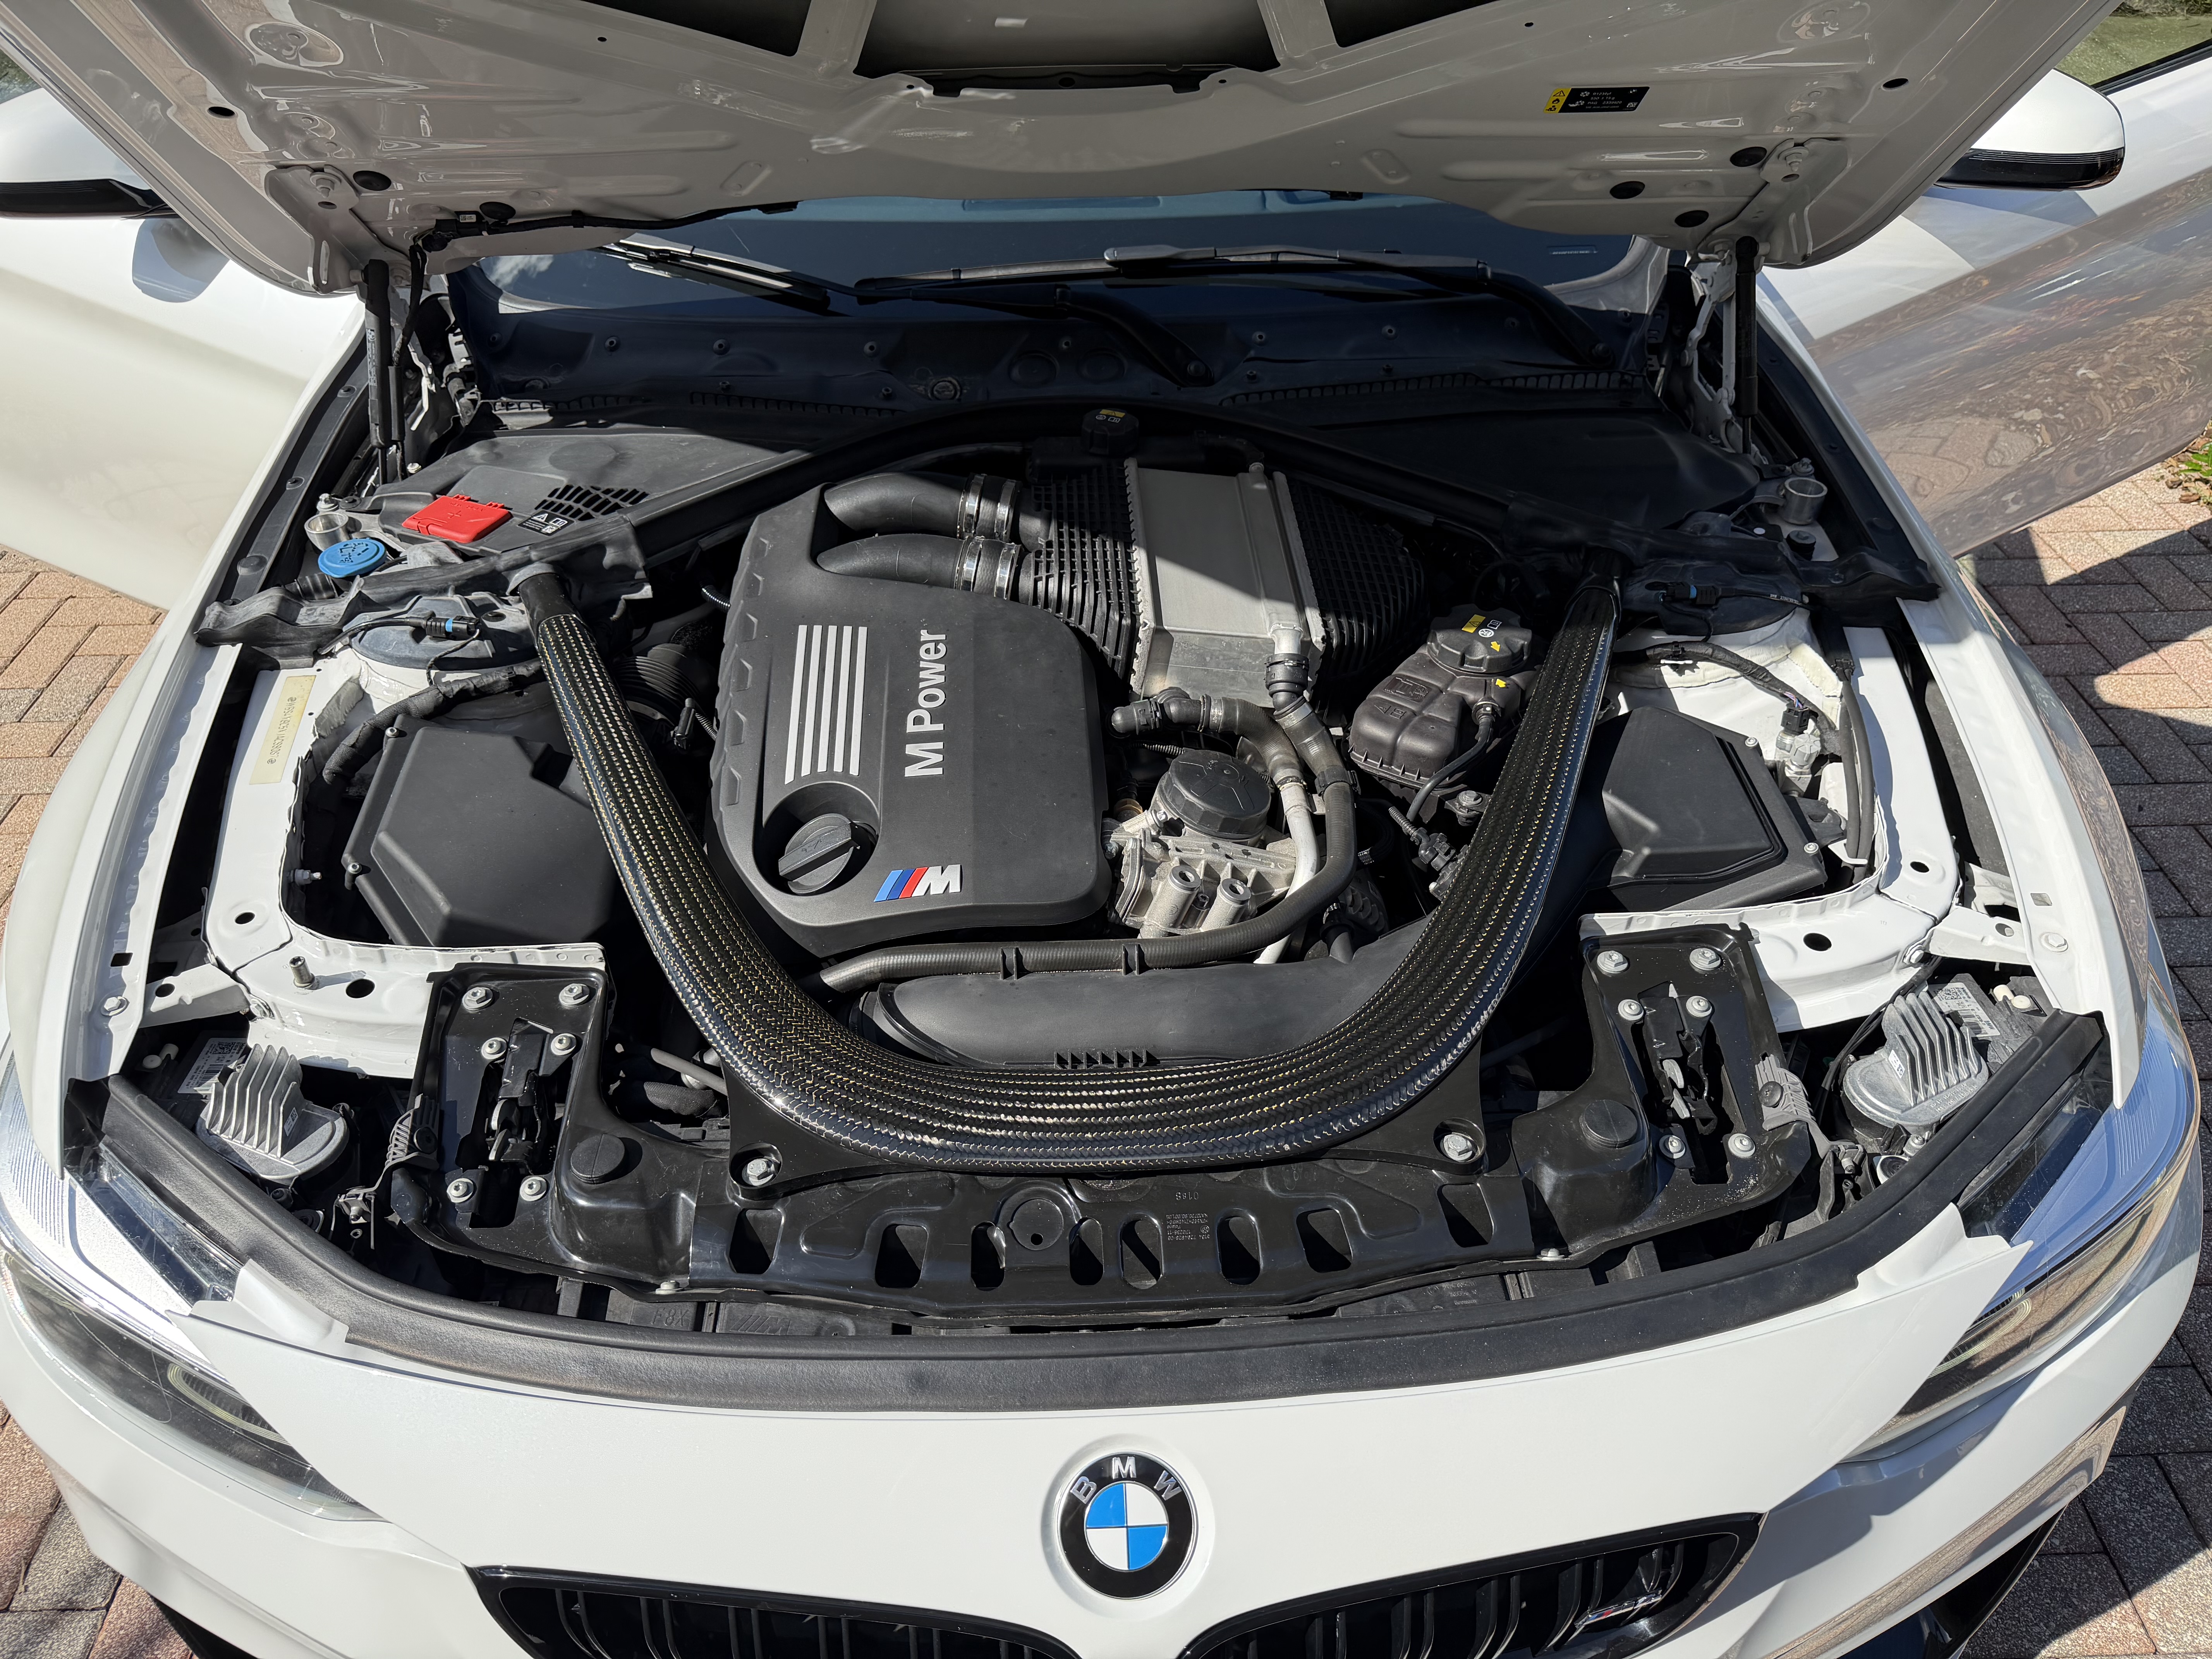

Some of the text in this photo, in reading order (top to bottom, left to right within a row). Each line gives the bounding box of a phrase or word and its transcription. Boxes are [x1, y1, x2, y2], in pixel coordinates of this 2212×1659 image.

[904, 629, 947, 778] M Power
[1984, 1020, 1996, 1030] BMW
[1070, 1456, 1182, 1504] BMW
